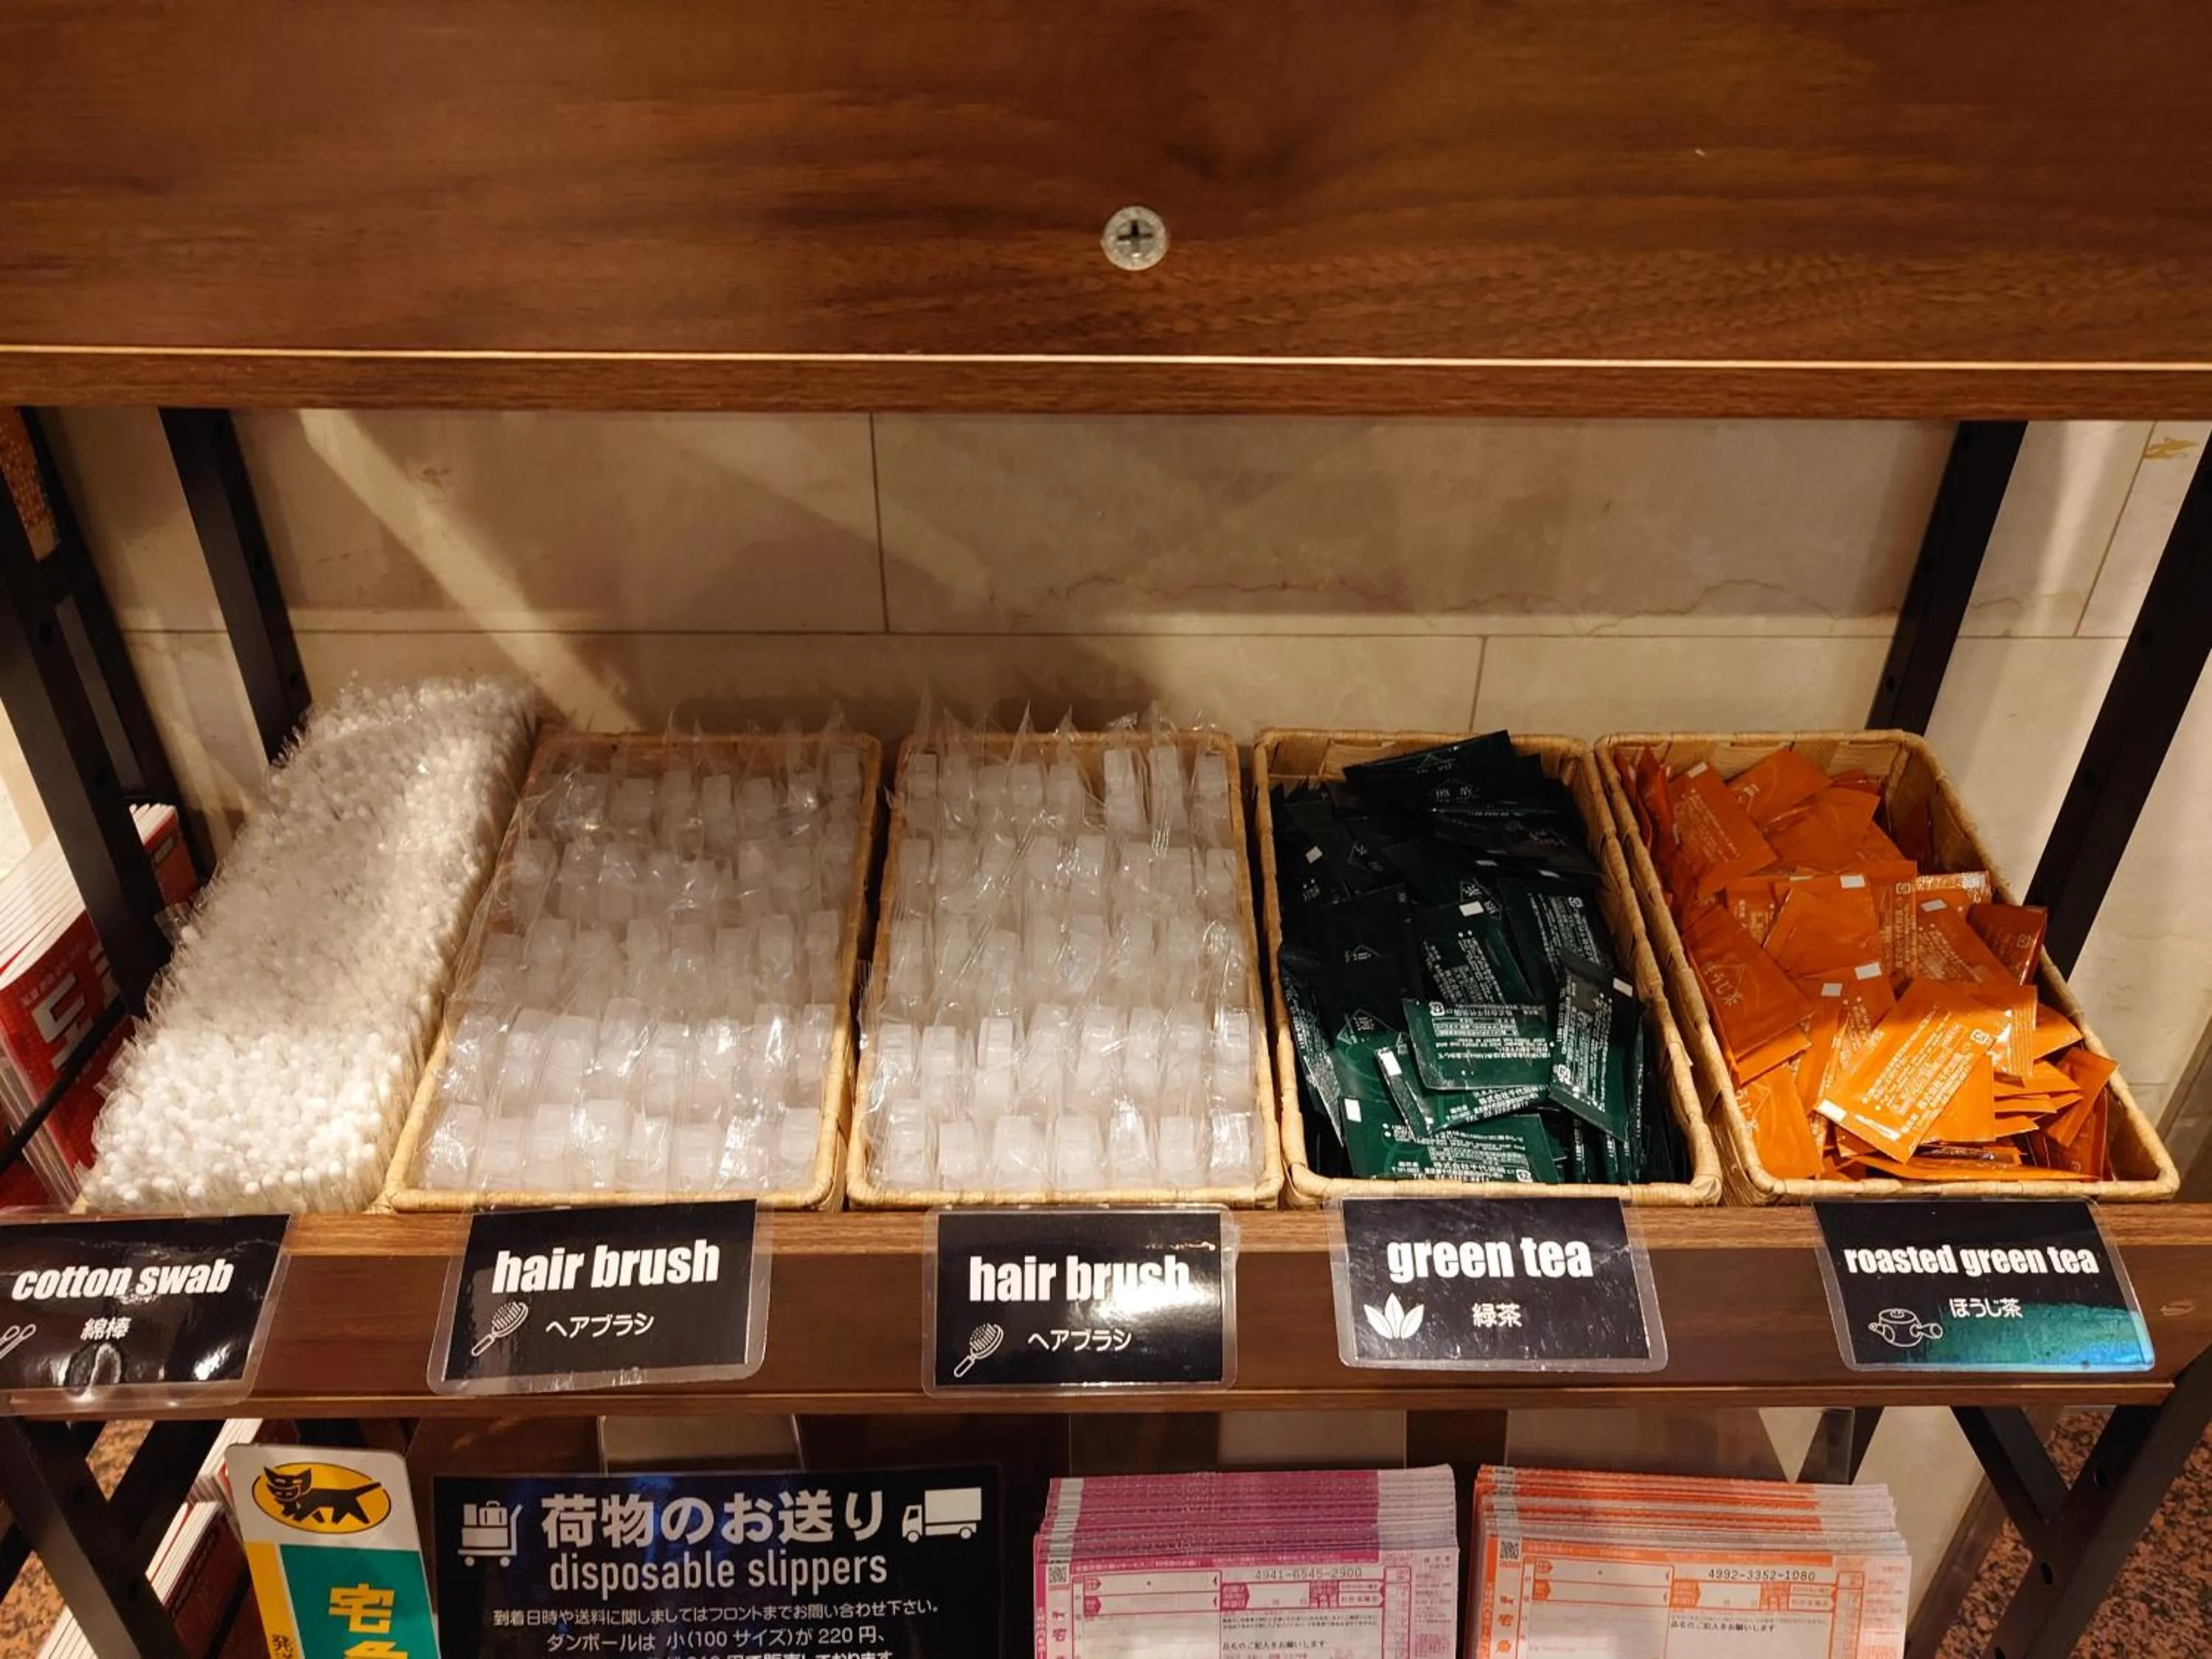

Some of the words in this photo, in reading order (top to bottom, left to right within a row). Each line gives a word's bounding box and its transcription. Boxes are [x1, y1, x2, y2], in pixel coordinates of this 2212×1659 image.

[492, 1248, 585, 1293] hair
[591, 1239, 720, 1288] brush
[1386, 1240, 1514, 1284] green
[1520, 1237, 1594, 1278] tea
[1843, 1245, 1959, 1274] roasted
[1960, 1248, 2048, 1277] green
[2048, 1246, 2099, 1274] tea
[12, 1266, 133, 1301] cotton
[135, 1259, 234, 1293] swab
[969, 1255, 1057, 1301] hair
[1065, 1255, 1190, 1301] brush
[1471, 1302, 1523, 1328] 緑茶
[1949, 1298, 2023, 1318] ほうじ茶
[80, 1317, 131, 1340] 綿棒
[546, 1312, 654, 1338] ヘアブラシ
[1028, 1329, 1132, 1352] ヘアブラシ
[540, 1489, 883, 1548] 荷物のお送り
[549, 1550, 735, 1600] disposable
[748, 1549, 887, 1596] slippers
[1708, 1568, 1816, 1582] 4992-3352-1080
[546, 1633, 655, 1652] ダンボールは
[818, 1627, 853, 1644] 220
